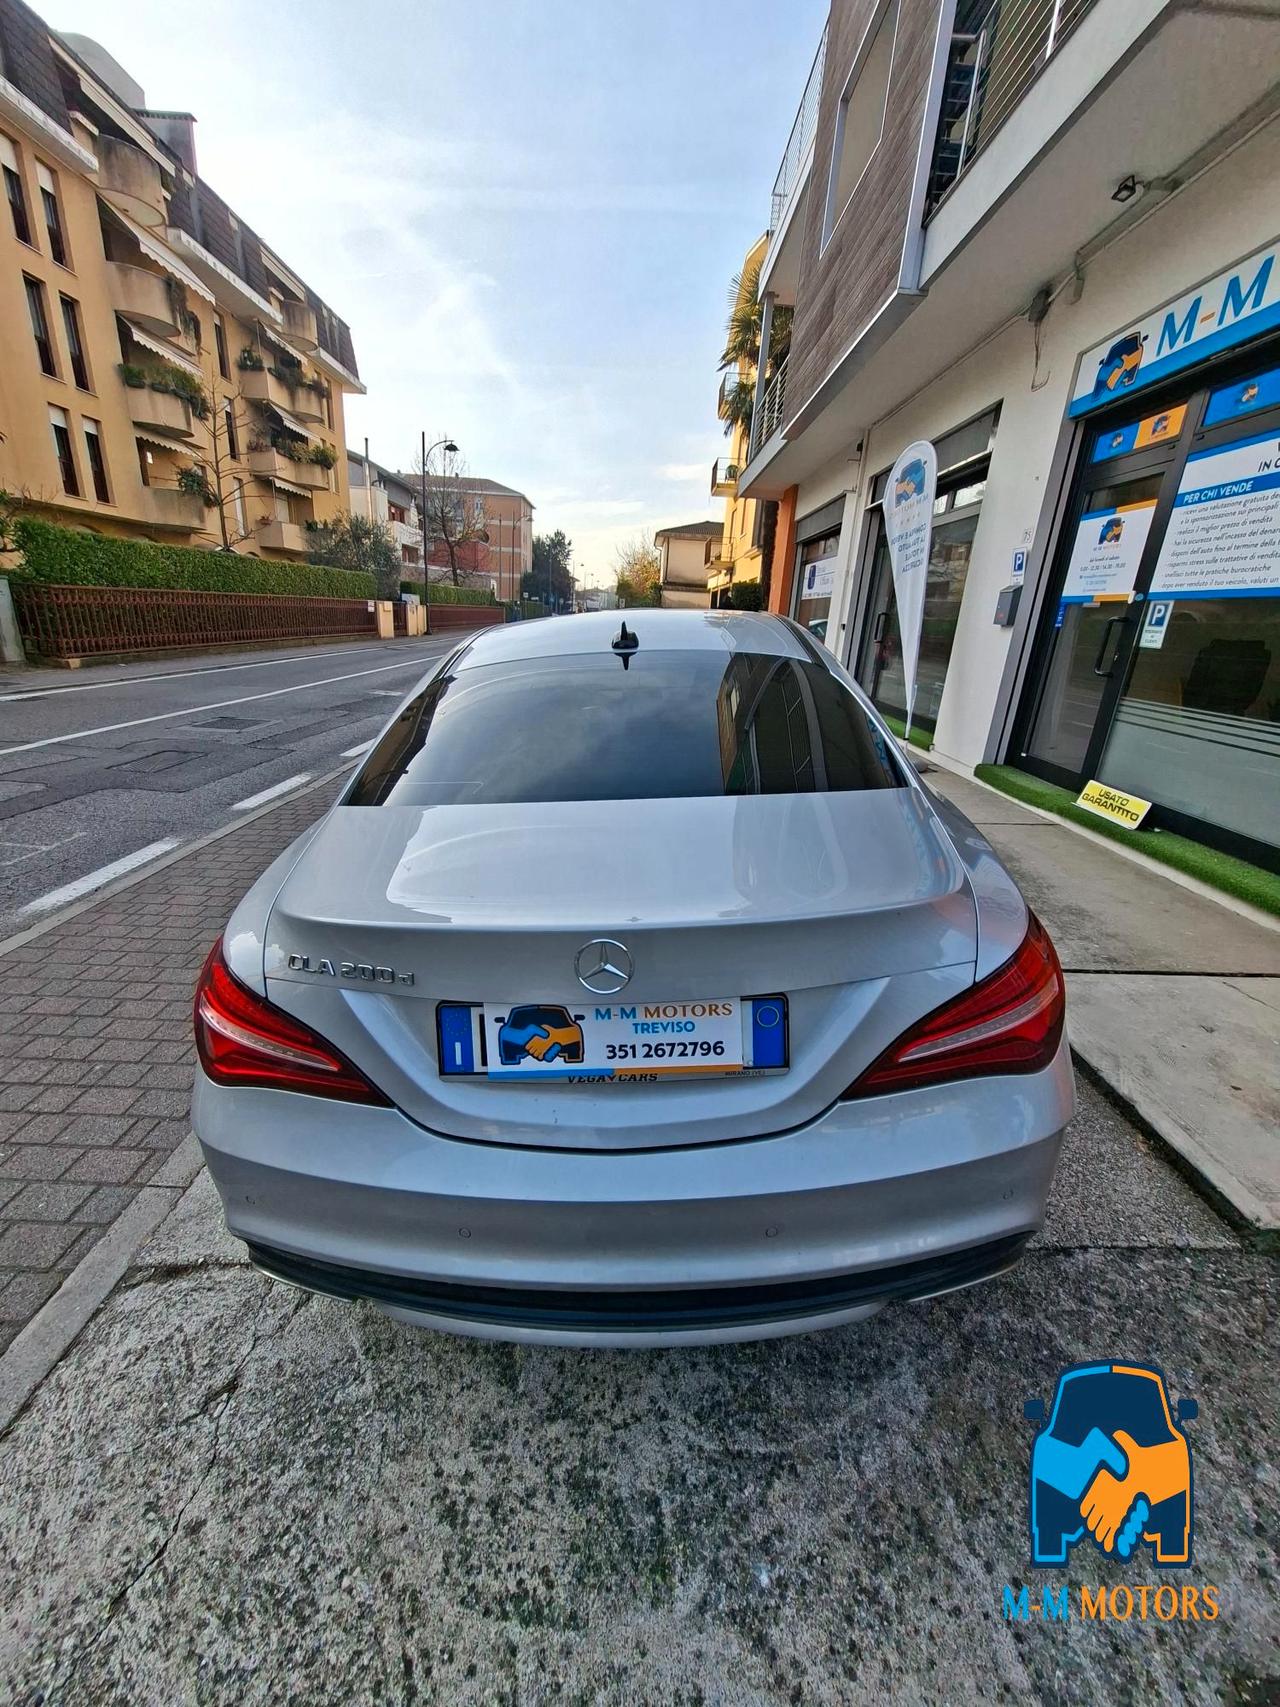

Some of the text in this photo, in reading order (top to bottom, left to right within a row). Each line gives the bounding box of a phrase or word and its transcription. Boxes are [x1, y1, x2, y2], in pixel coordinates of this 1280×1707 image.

[1156, 254, 1275, 357] M-M
[1257, 459, 1272, 472] IN
[1183, 480, 1254, 504] PER CHI VENDE
[1249, 516, 1273, 525] vendita
[1248, 530, 1259, 539] del
[1259, 527, 1280, 537] denar
[1234, 541, 1258, 550] termine
[1259, 538, 1276, 548] della
[1015, 553, 1023, 570] P
[1219, 553, 1248, 564] trattative
[1249, 552, 1257, 561] di
[1230, 563, 1271, 574] burocratiche
[1151, 604, 1166, 625] P
[1098, 789, 1130, 807] USATO
[1082, 793, 1140, 822] GARANTITO
[288, 953, 415, 986] CLA 200 d
[595, 1002, 733, 1021] M-M MOTORS
[632, 1021, 695, 1034] TREVISO
[606, 1040, 725, 1060] 351 2672796
[618, 1073, 658, 1082] CARS
